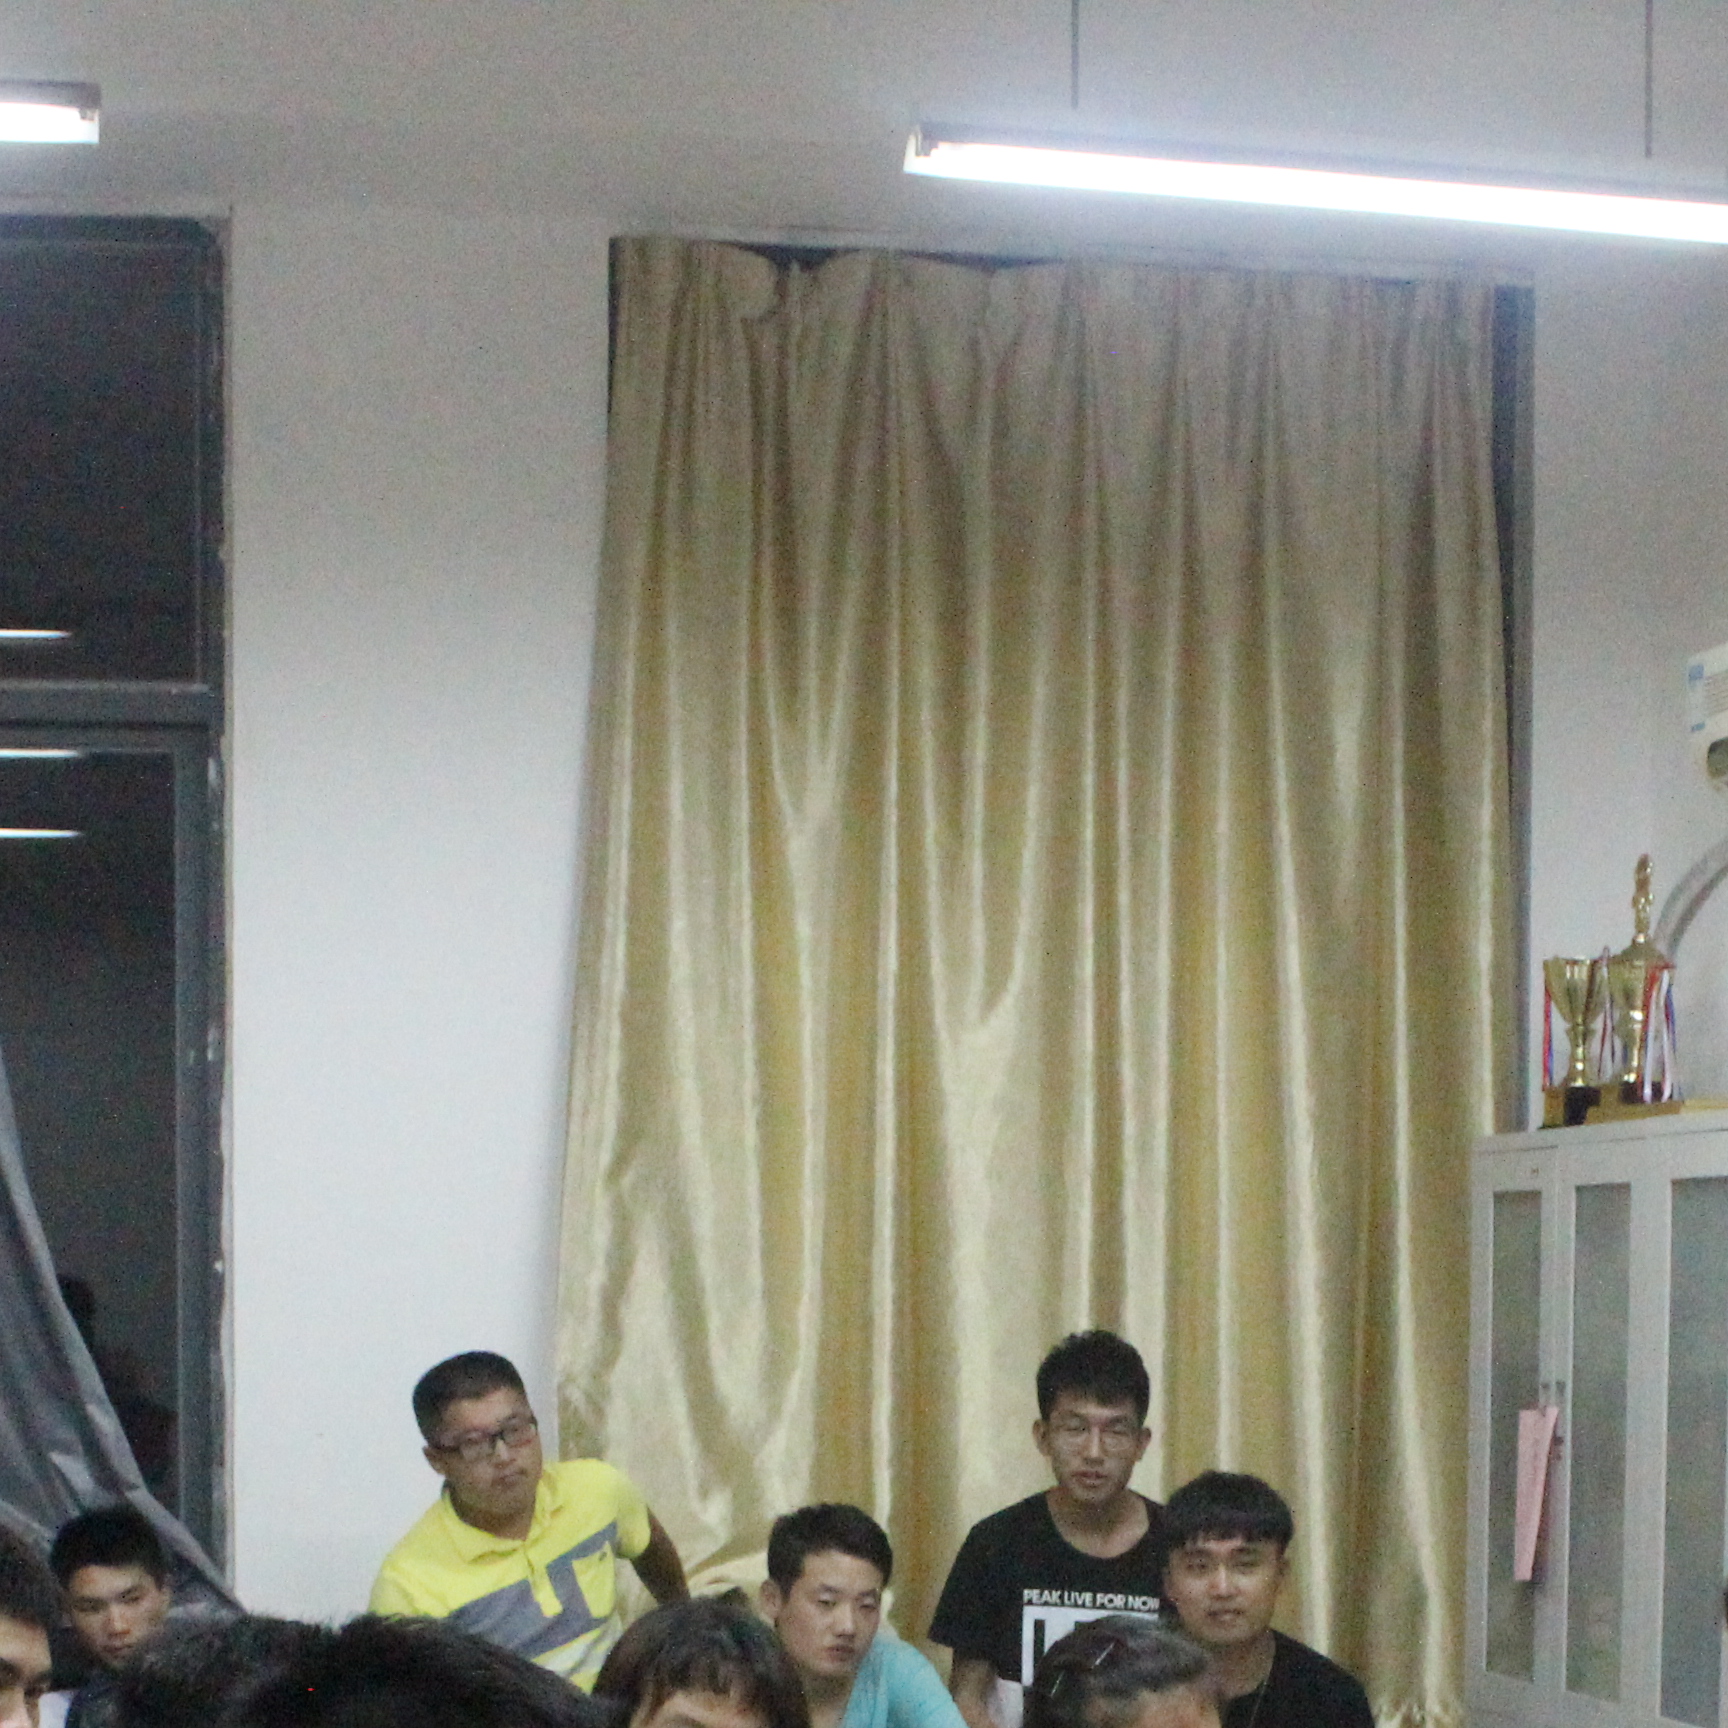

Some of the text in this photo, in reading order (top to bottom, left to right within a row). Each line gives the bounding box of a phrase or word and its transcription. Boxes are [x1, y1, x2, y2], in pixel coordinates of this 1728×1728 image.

[1023, 1588, 1062, 1606] PEAK
[1063, 1590, 1094, 1608] LIVE
[1096, 1593, 1127, 1610] FOR
